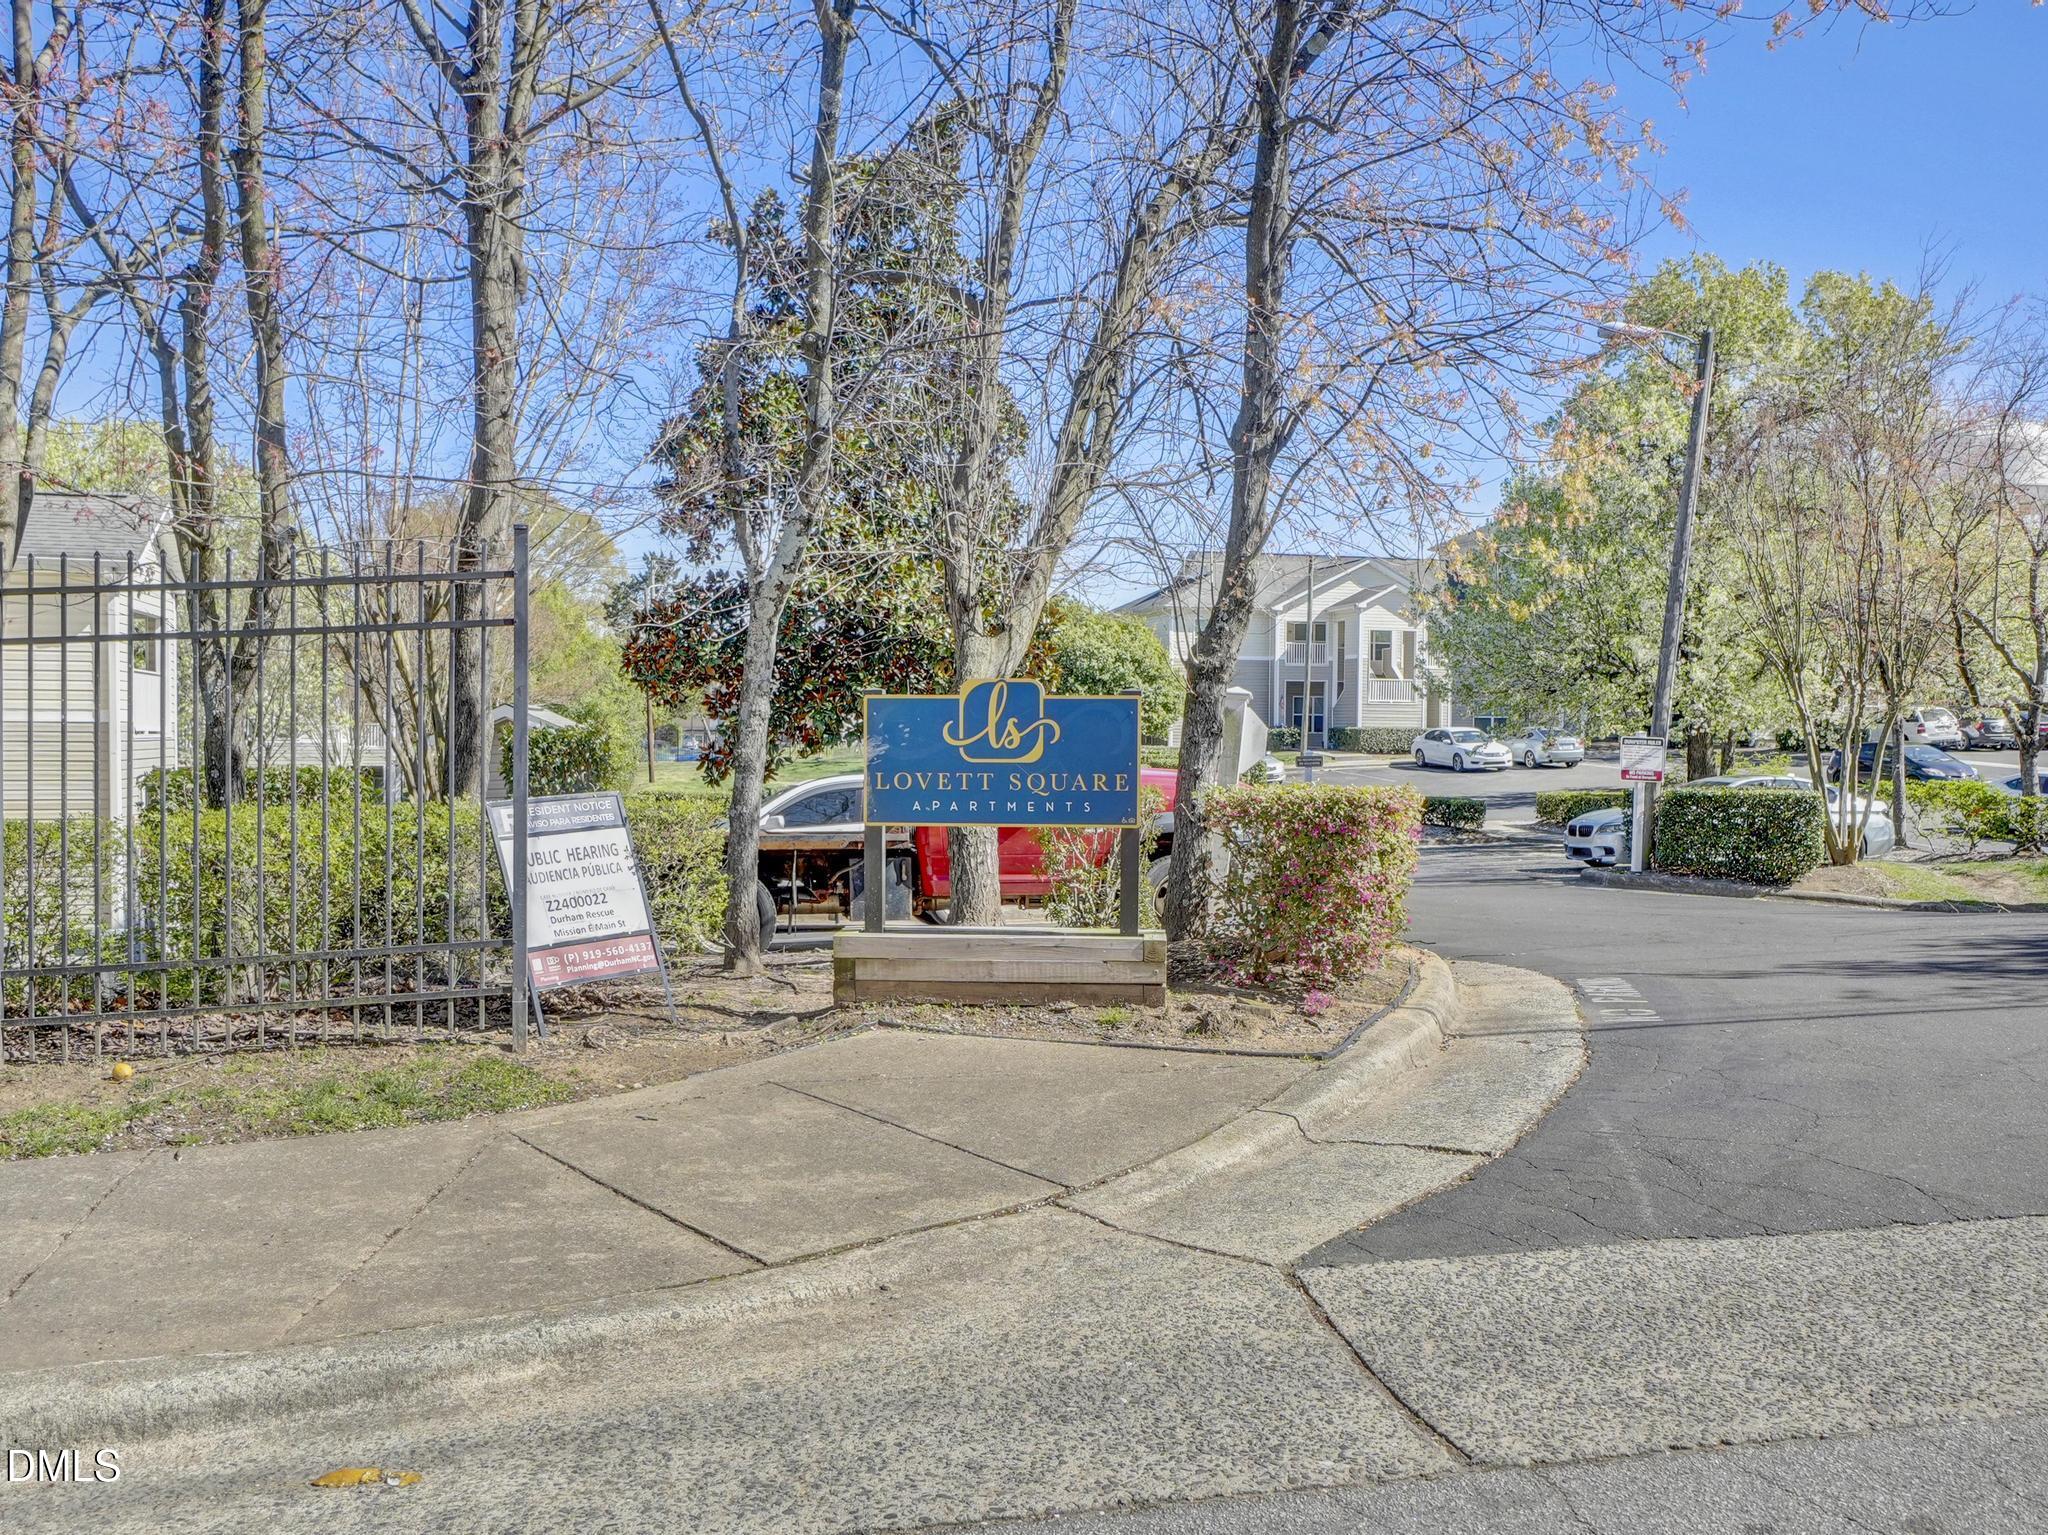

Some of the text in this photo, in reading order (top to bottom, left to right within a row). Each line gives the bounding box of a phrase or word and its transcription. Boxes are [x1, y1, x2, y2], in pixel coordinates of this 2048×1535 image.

[874, 772, 1130, 796] LOVETT SQUARE
[527, 800, 612, 817] ESIDENT NOTICE
[912, 801, 1092, 812] APARTMENTS
[549, 817, 571, 826] PARA
[570, 813, 615, 824] RESIDENTES
[527, 843, 620, 867] UBLIC HEARING
[581, 862, 623, 878] PÚBLICA
[545, 892, 608, 912] Z2400022
[550, 909, 615, 925] Durham Rescue
[554, 926, 587, 938] Mission
[595, 922, 616, 932] Main
[618, 918, 627, 928] St
[563, 951, 579, 965] (P)
[582, 941, 652, 961] 919-560-4137
[566, 954, 656, 973] Planning@DurhamNC.gov
